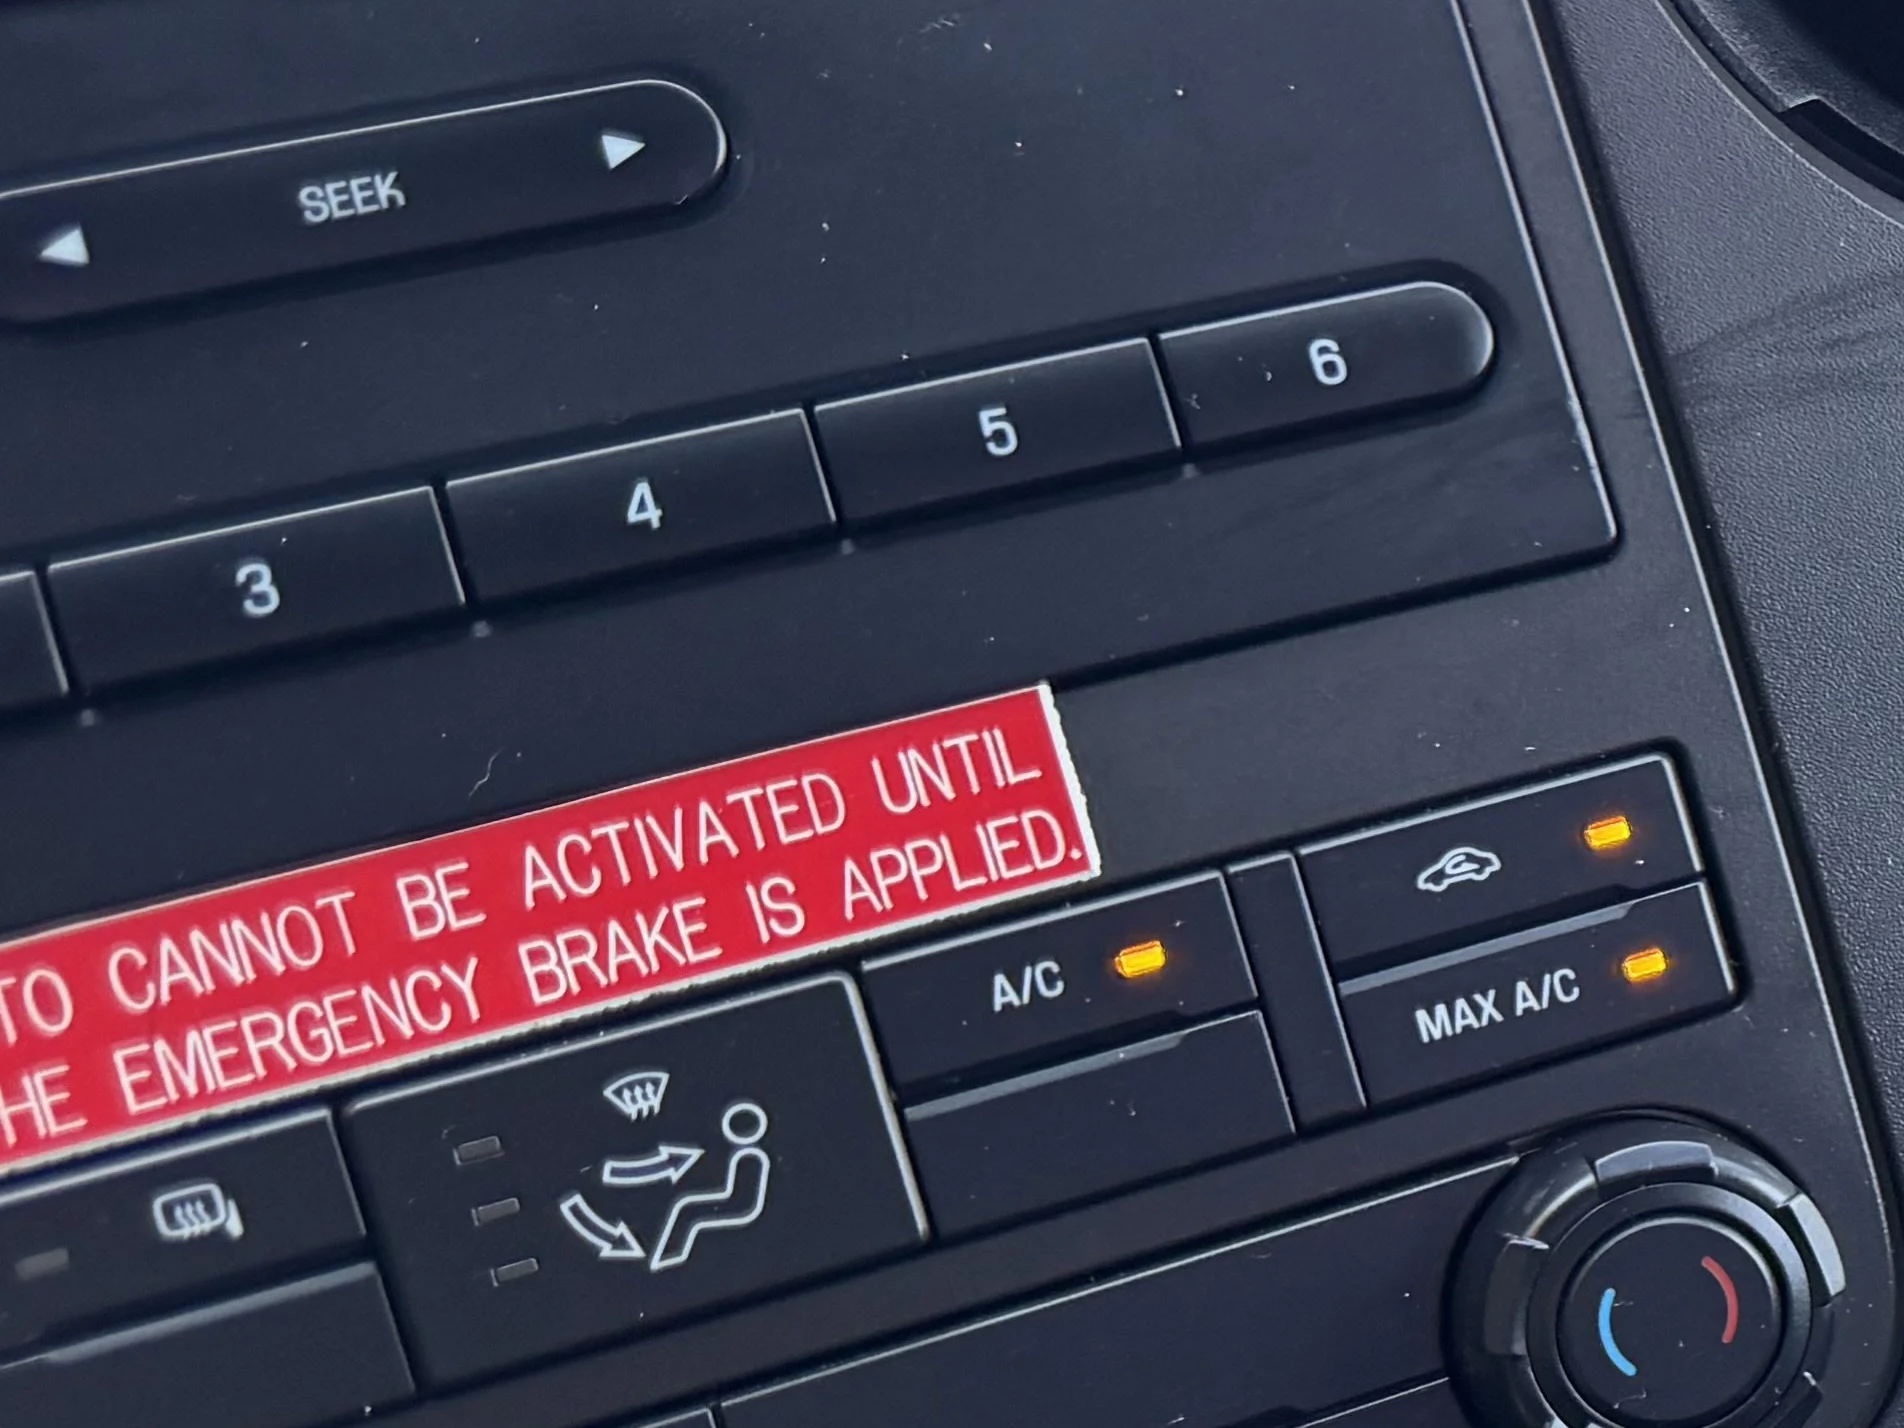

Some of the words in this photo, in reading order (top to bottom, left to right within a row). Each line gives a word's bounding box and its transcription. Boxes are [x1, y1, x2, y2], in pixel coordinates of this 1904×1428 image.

[299, 171, 407, 224] SEEK
[1307, 337, 1349, 386] 6
[976, 406, 1020, 458] 5
[625, 481, 663, 531] 4
[234, 560, 281, 616] 3
[107, 890, 357, 1015] CANNOT
[396, 861, 487, 941] BE
[523, 771, 846, 910] ACTIVATED
[871, 726, 1043, 815] UNTIL
[112, 956, 480, 1117] EMERGENCY
[517, 897, 723, 1006] BRAKE
[745, 876, 805, 945] IS
[843, 807, 1083, 921] APPLIED.
[992, 960, 1066, 1014] A/C
[1414, 990, 1504, 1046] MAX
[1514, 967, 1582, 1020] A/C
